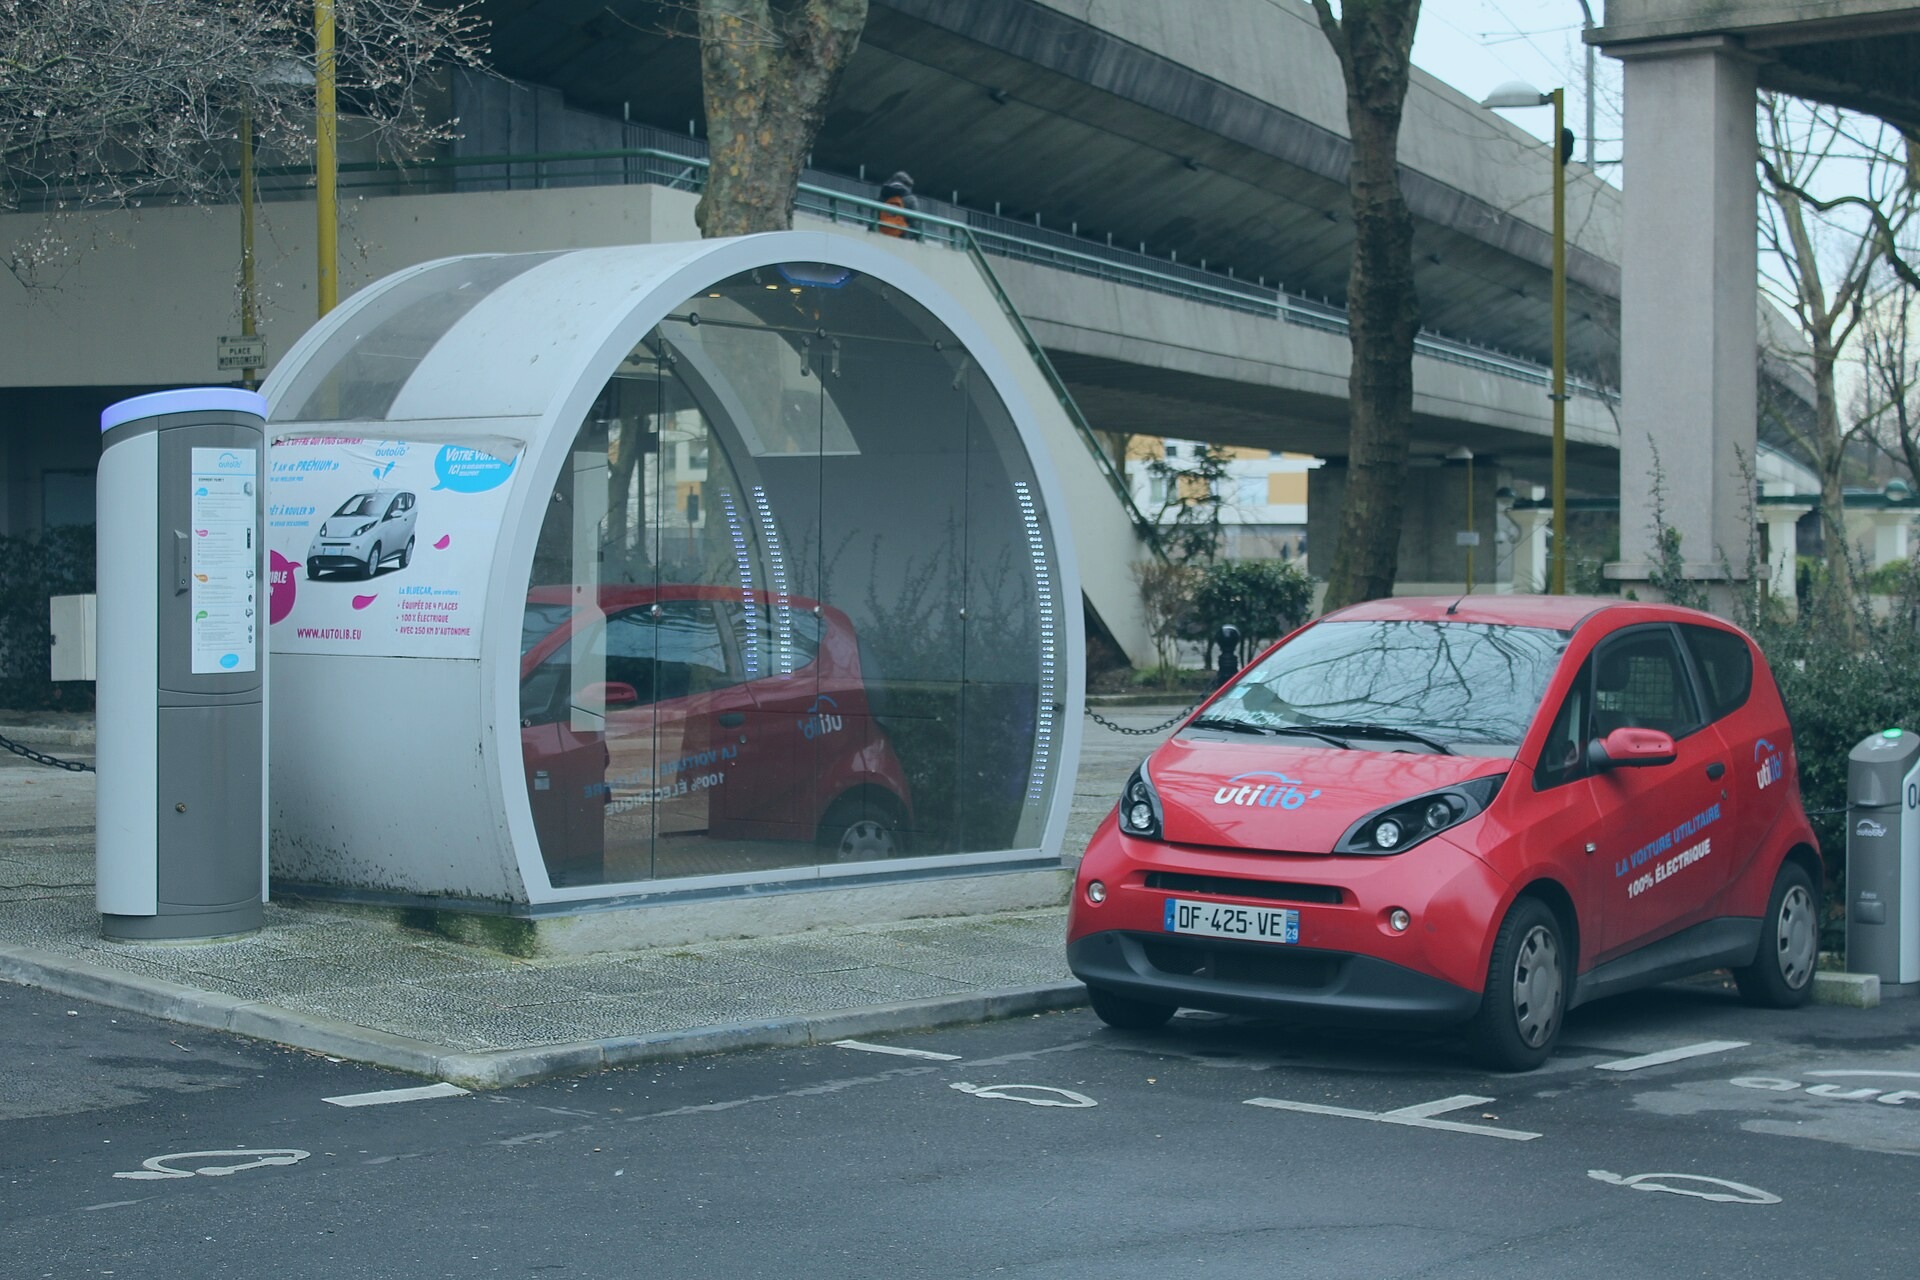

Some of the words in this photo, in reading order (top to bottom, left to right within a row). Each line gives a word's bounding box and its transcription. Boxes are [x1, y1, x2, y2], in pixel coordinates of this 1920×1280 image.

[229, 347, 251, 355] PLACE
[219, 355, 262, 366] MONTGOMERY
[446, 448, 475, 462] VOTRE
[296, 460, 331, 471] PREMIUM
[448, 465, 461, 475] ICI
[425, 602, 432, 610] DE
[438, 603, 458, 611] PLACES
[417, 612, 449, 623] ÉLECTRIQUE
[297, 628, 362, 640] WWW.AUTOLIB.EU
[400, 627, 414, 635] AVEC
[415, 627, 426, 635] 250
[435, 627, 471, 636] D'AUTONOMIE
[1615, 857, 1630, 878] LA
[1630, 831, 1673, 869] VOITURE
[1673, 802, 1723, 844] UTILITAIRE
[1627, 871, 1655, 900] 100%
[1654, 836, 1712, 884] ÉLECTRIQUE
[1286, 928, 1299, 941] 29
